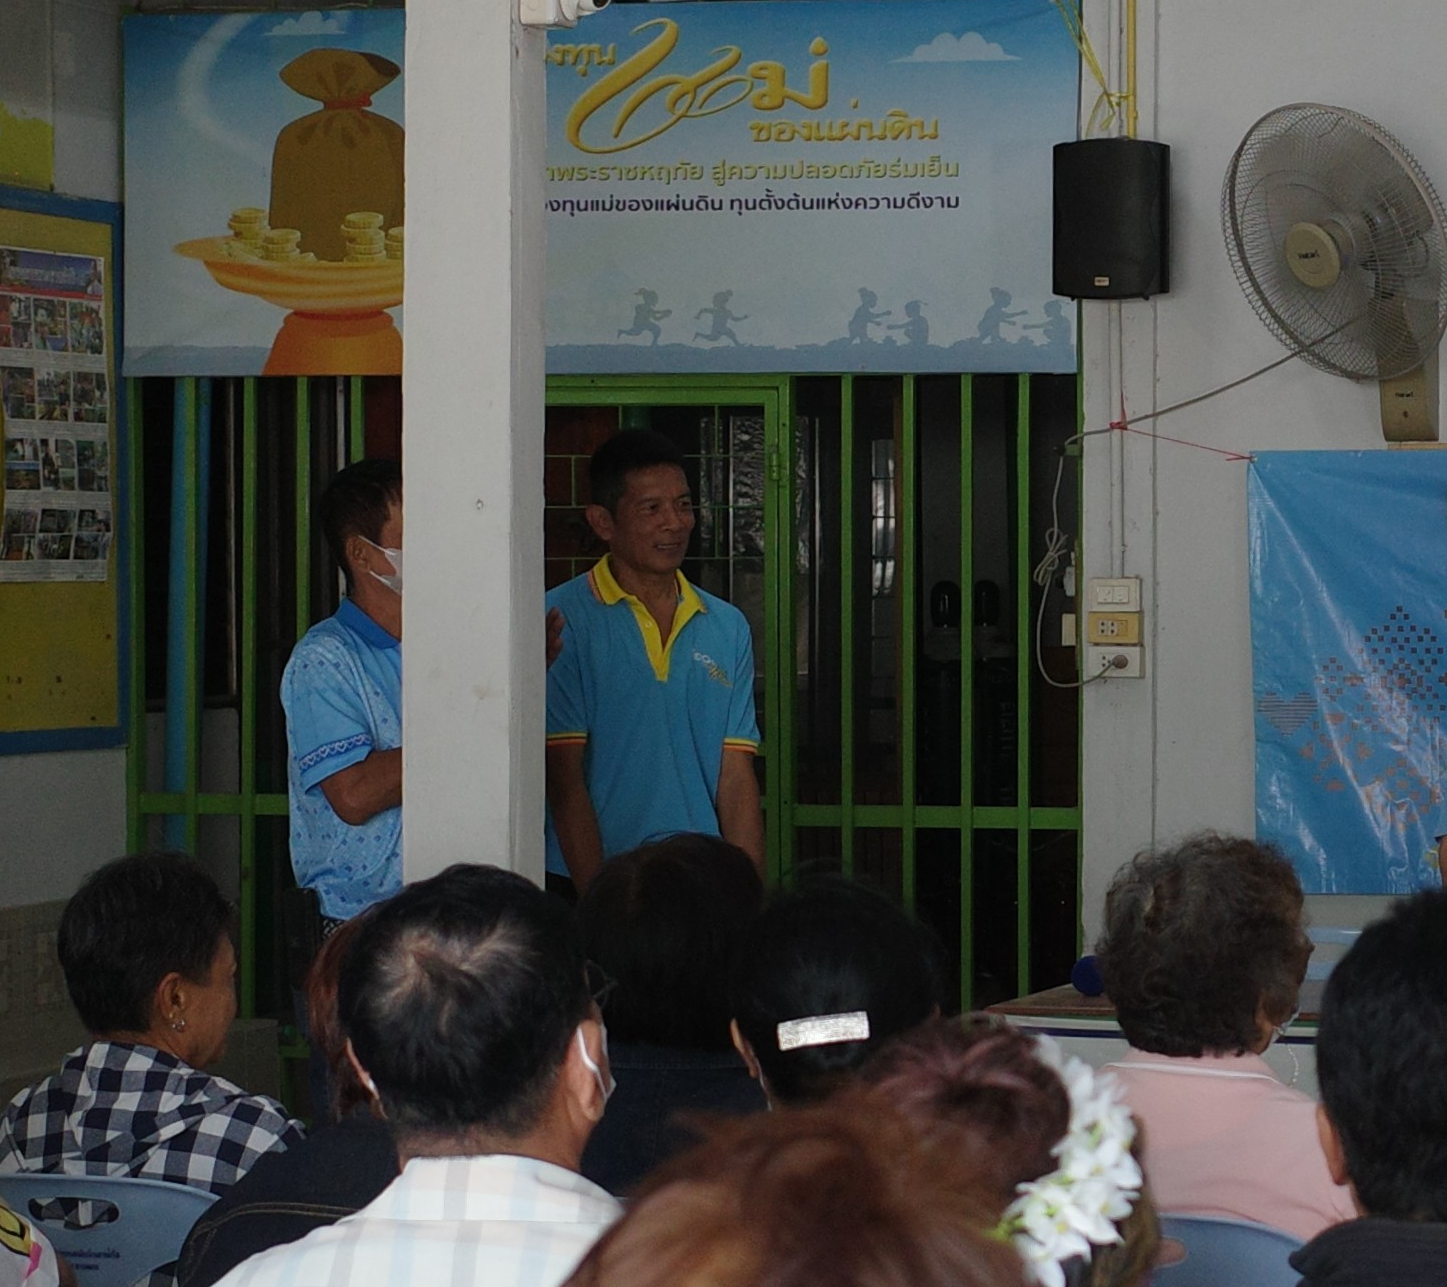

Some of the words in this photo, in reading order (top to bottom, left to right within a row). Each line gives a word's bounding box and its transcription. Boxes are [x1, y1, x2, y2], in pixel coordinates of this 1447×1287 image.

[748, 98, 939, 143] ของแผ่นดิน
[711, 156, 959, 188] สู่ความปลอดภัยร่มเย็น
[545, 192, 723, 218] งทุนแม่ของแผ่นดิน
[729, 187, 960, 218] ทุนตั้งต้นแห่งความดีงาม
